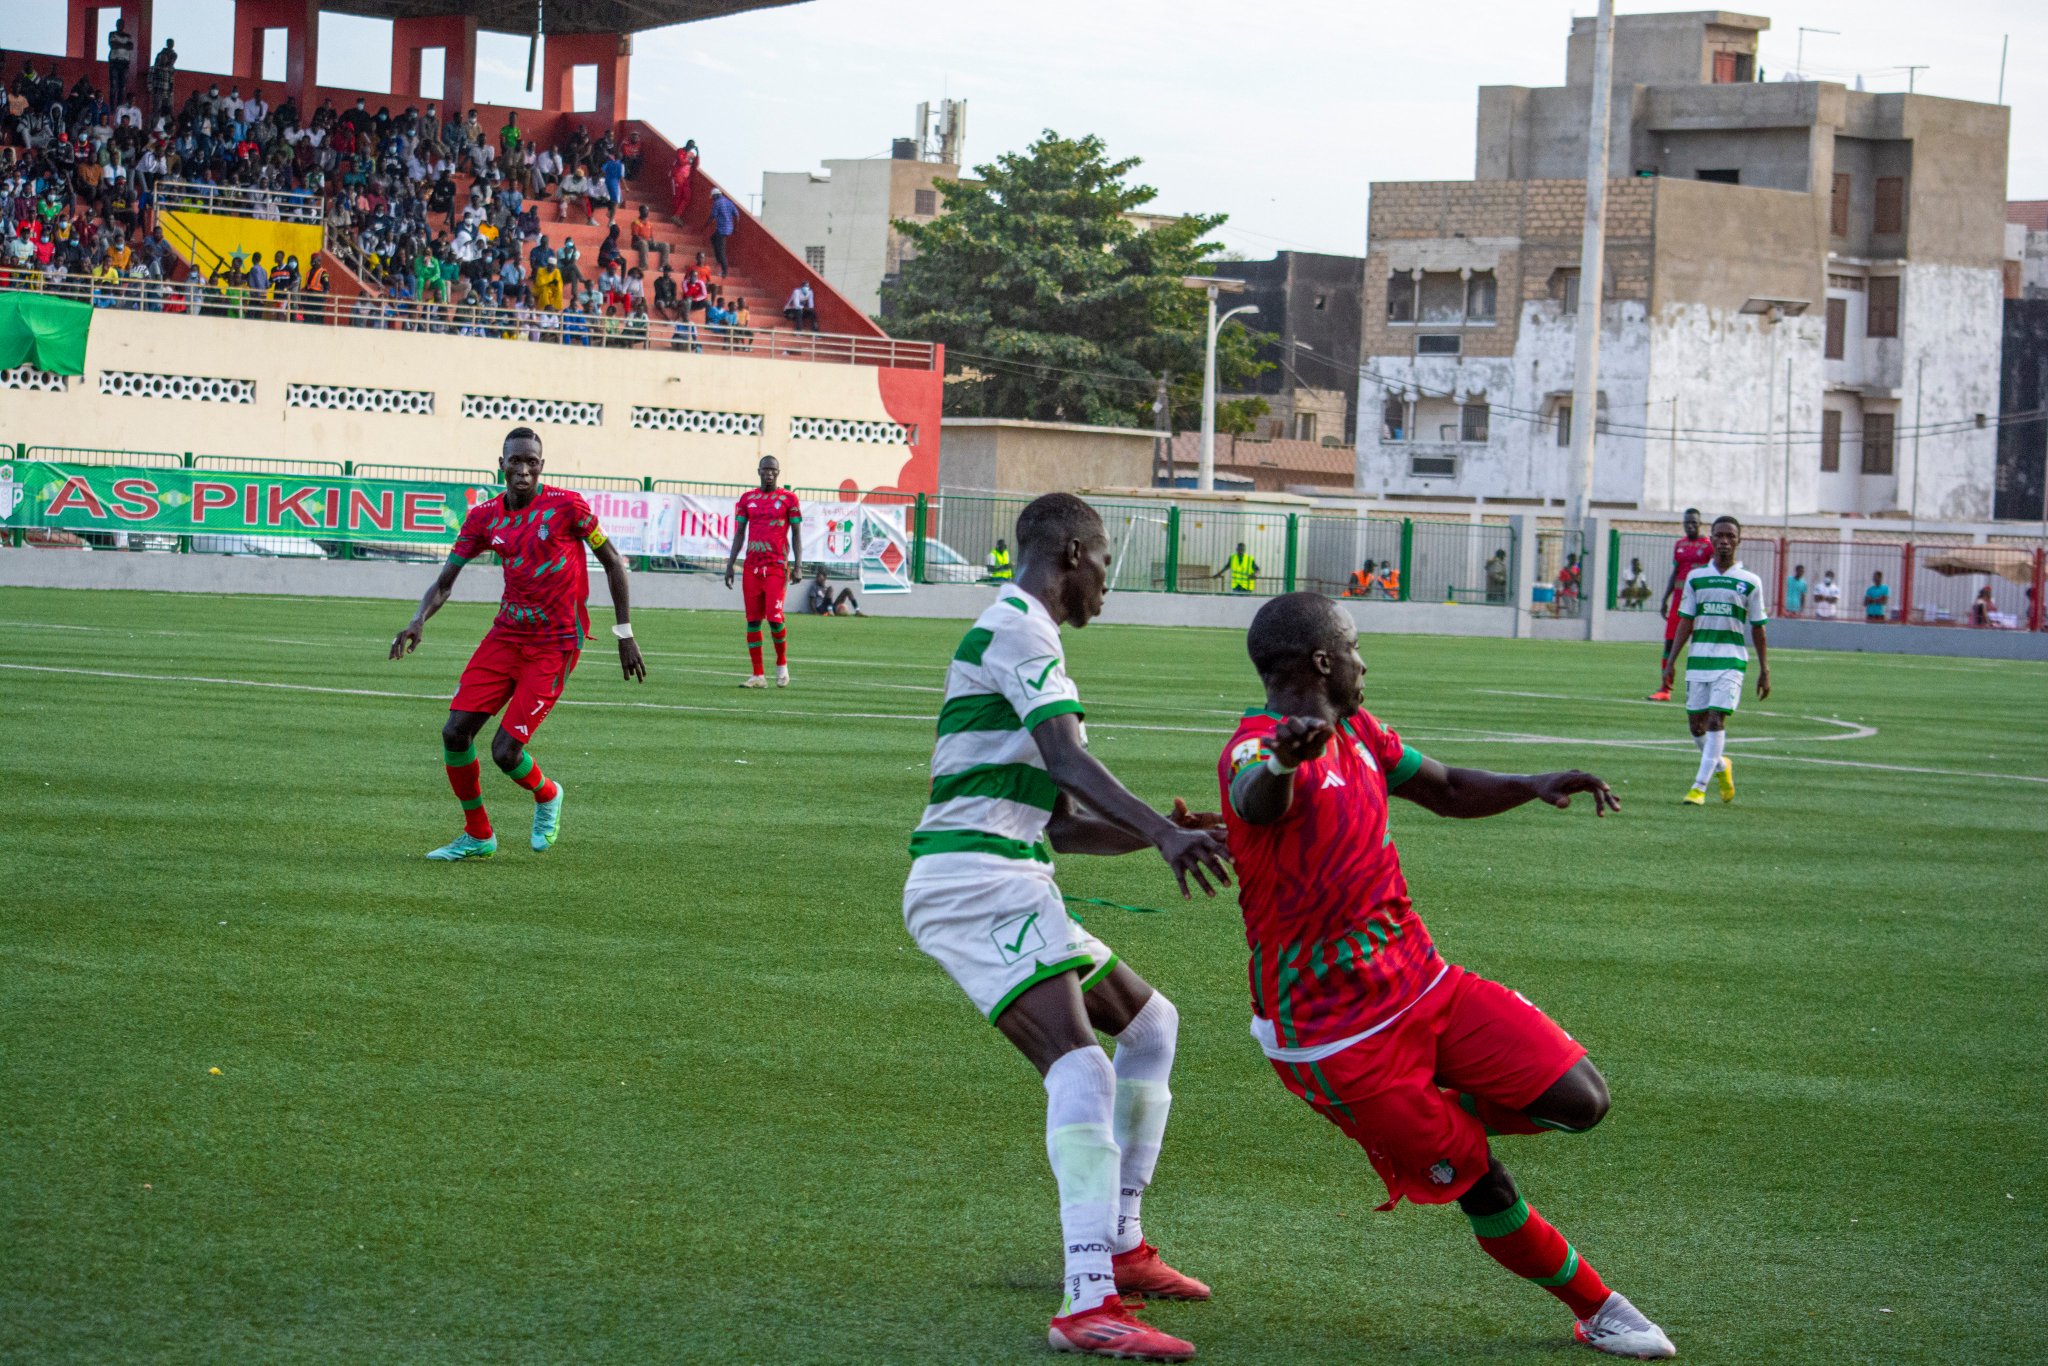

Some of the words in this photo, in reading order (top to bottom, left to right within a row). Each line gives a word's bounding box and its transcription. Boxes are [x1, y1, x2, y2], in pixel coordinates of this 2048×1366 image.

[44, 475, 160, 521] AS
[191, 481, 447, 534] PIKINE
[1703, 602, 1733, 616] SMASH
[530, 700, 545, 716] 7
